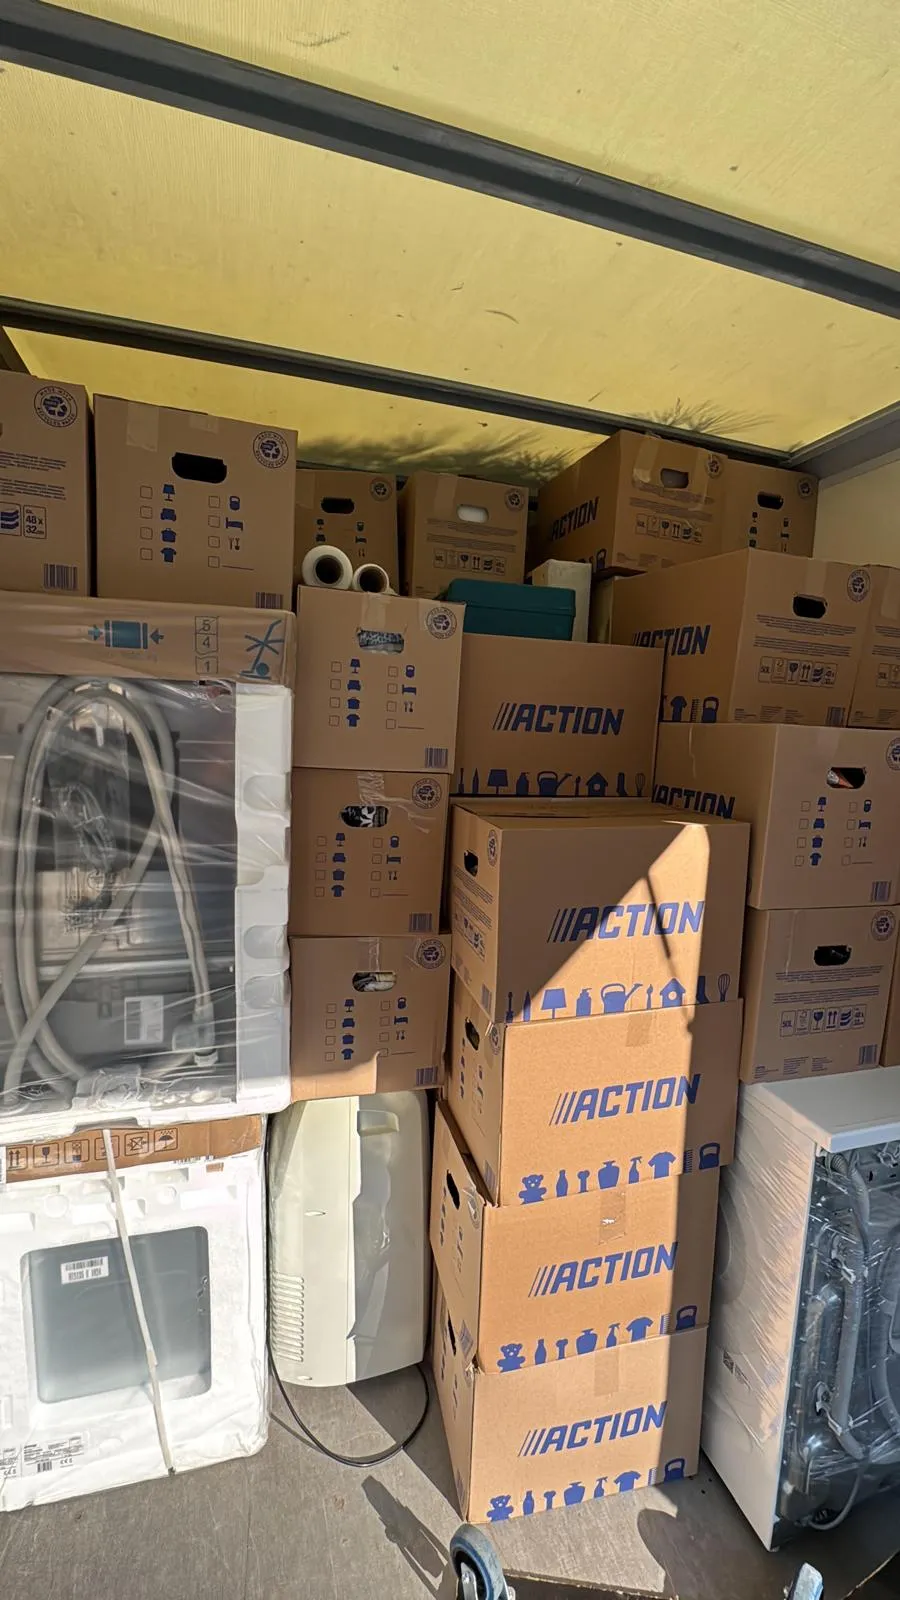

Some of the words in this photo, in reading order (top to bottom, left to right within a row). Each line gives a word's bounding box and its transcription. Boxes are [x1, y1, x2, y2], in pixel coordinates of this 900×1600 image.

[26, 515, 37, 525] 48
[551, 496, 599, 541] ACTION
[202, 636, 210, 649] 4
[204, 660, 210, 673] 1
[511, 703, 625, 736] ACTION
[569, 900, 705, 942] ACTION
[570, 1073, 701, 1123] ACTION
[550, 1241, 679, 1295] ACTION
[539, 1400, 668, 1455] ACTION
